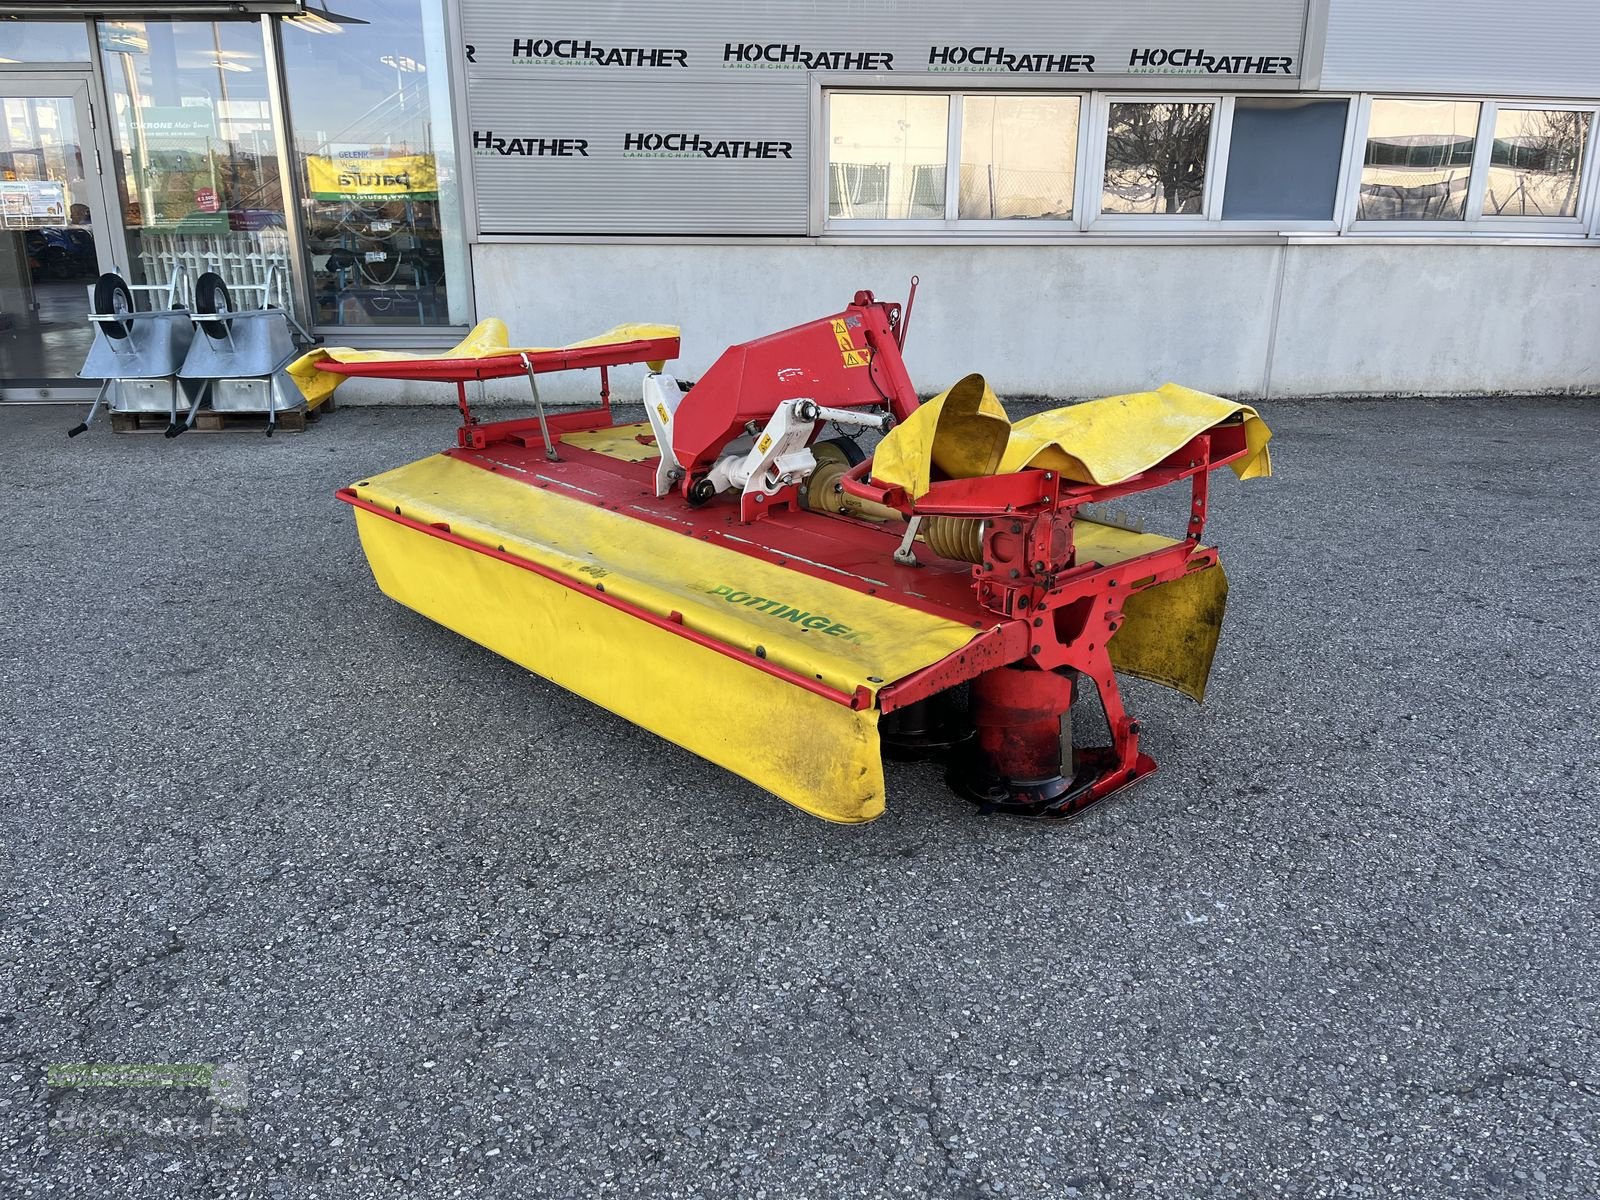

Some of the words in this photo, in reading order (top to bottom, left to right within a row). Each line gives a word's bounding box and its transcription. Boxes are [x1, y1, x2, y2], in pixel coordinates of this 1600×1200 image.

[511, 58, 595, 66] LANDTECHNIK
[512, 38, 688, 68] HOCHRATHER
[723, 43, 894, 71] HOCHRATHER
[929, 46, 1095, 73] HOCHRATHER
[1129, 48, 1293, 74] HOCHRATHER
[338, 151, 370, 159] GELENK
[624, 133, 793, 159] HOCHRATHER
